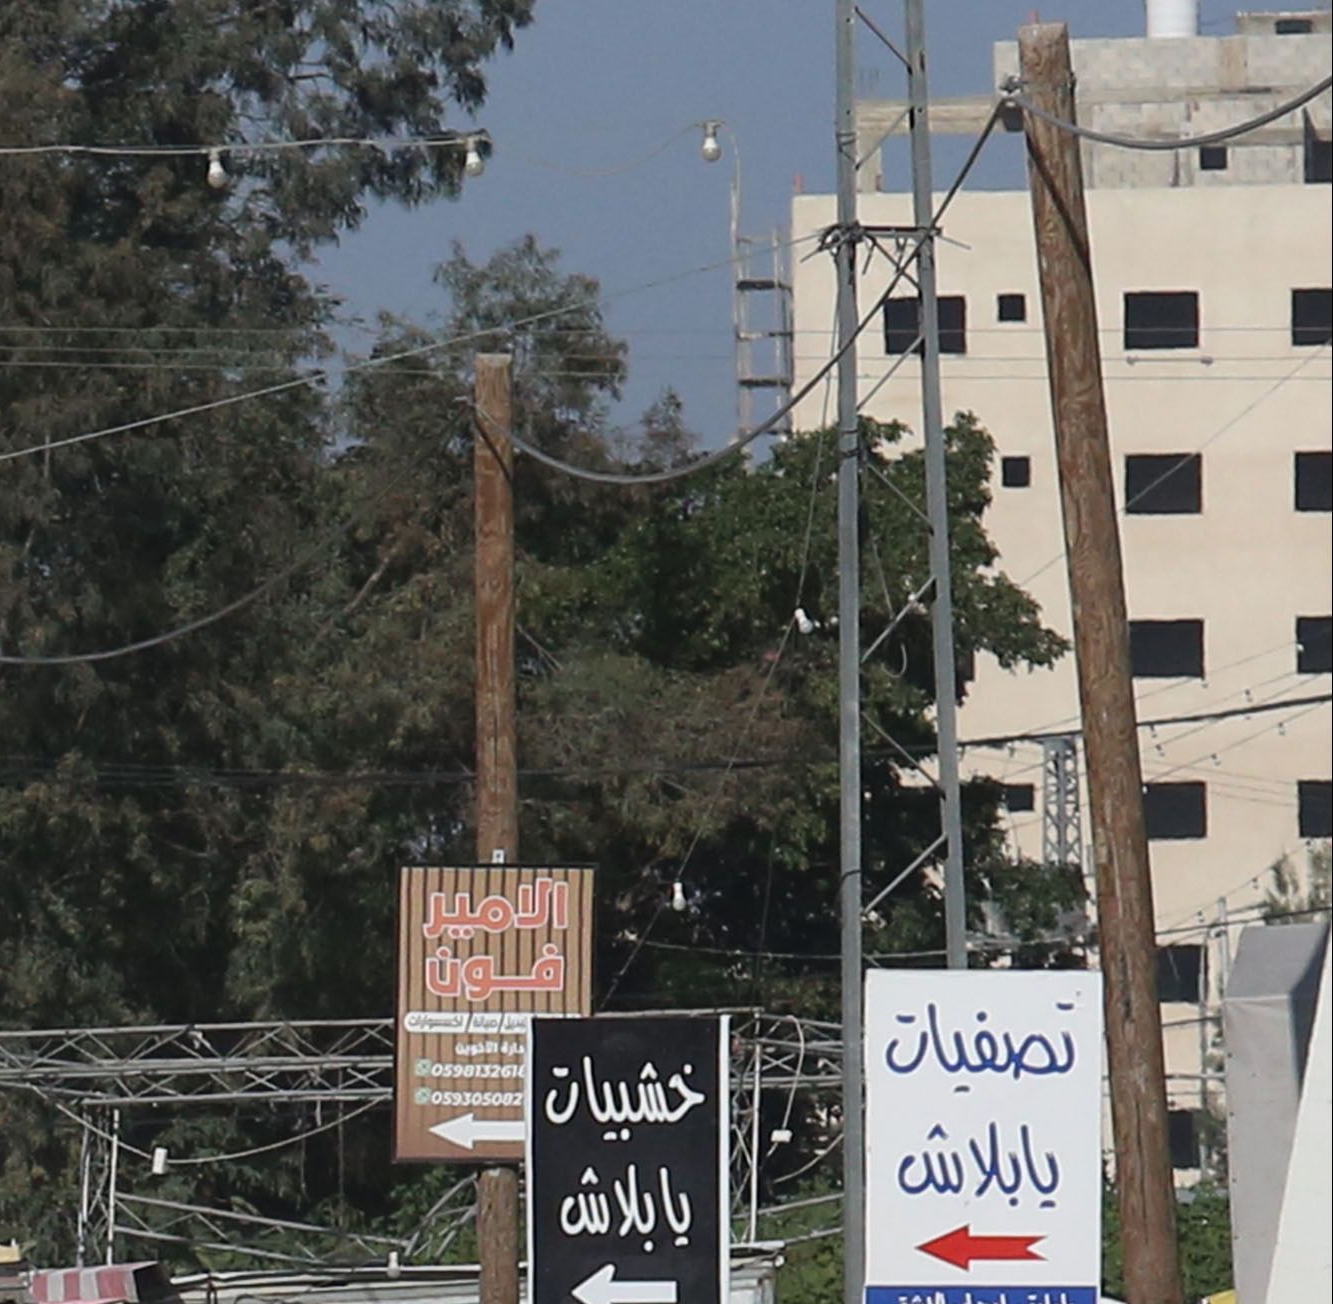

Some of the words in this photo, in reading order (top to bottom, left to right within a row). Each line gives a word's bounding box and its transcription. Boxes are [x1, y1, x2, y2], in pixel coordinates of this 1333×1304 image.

[423, 877, 568, 939] الامير
[426, 943, 564, 1001] فون
[885, 1002, 1075, 1093] تصفيات
[545, 1055, 705, 1141] خشبيات
